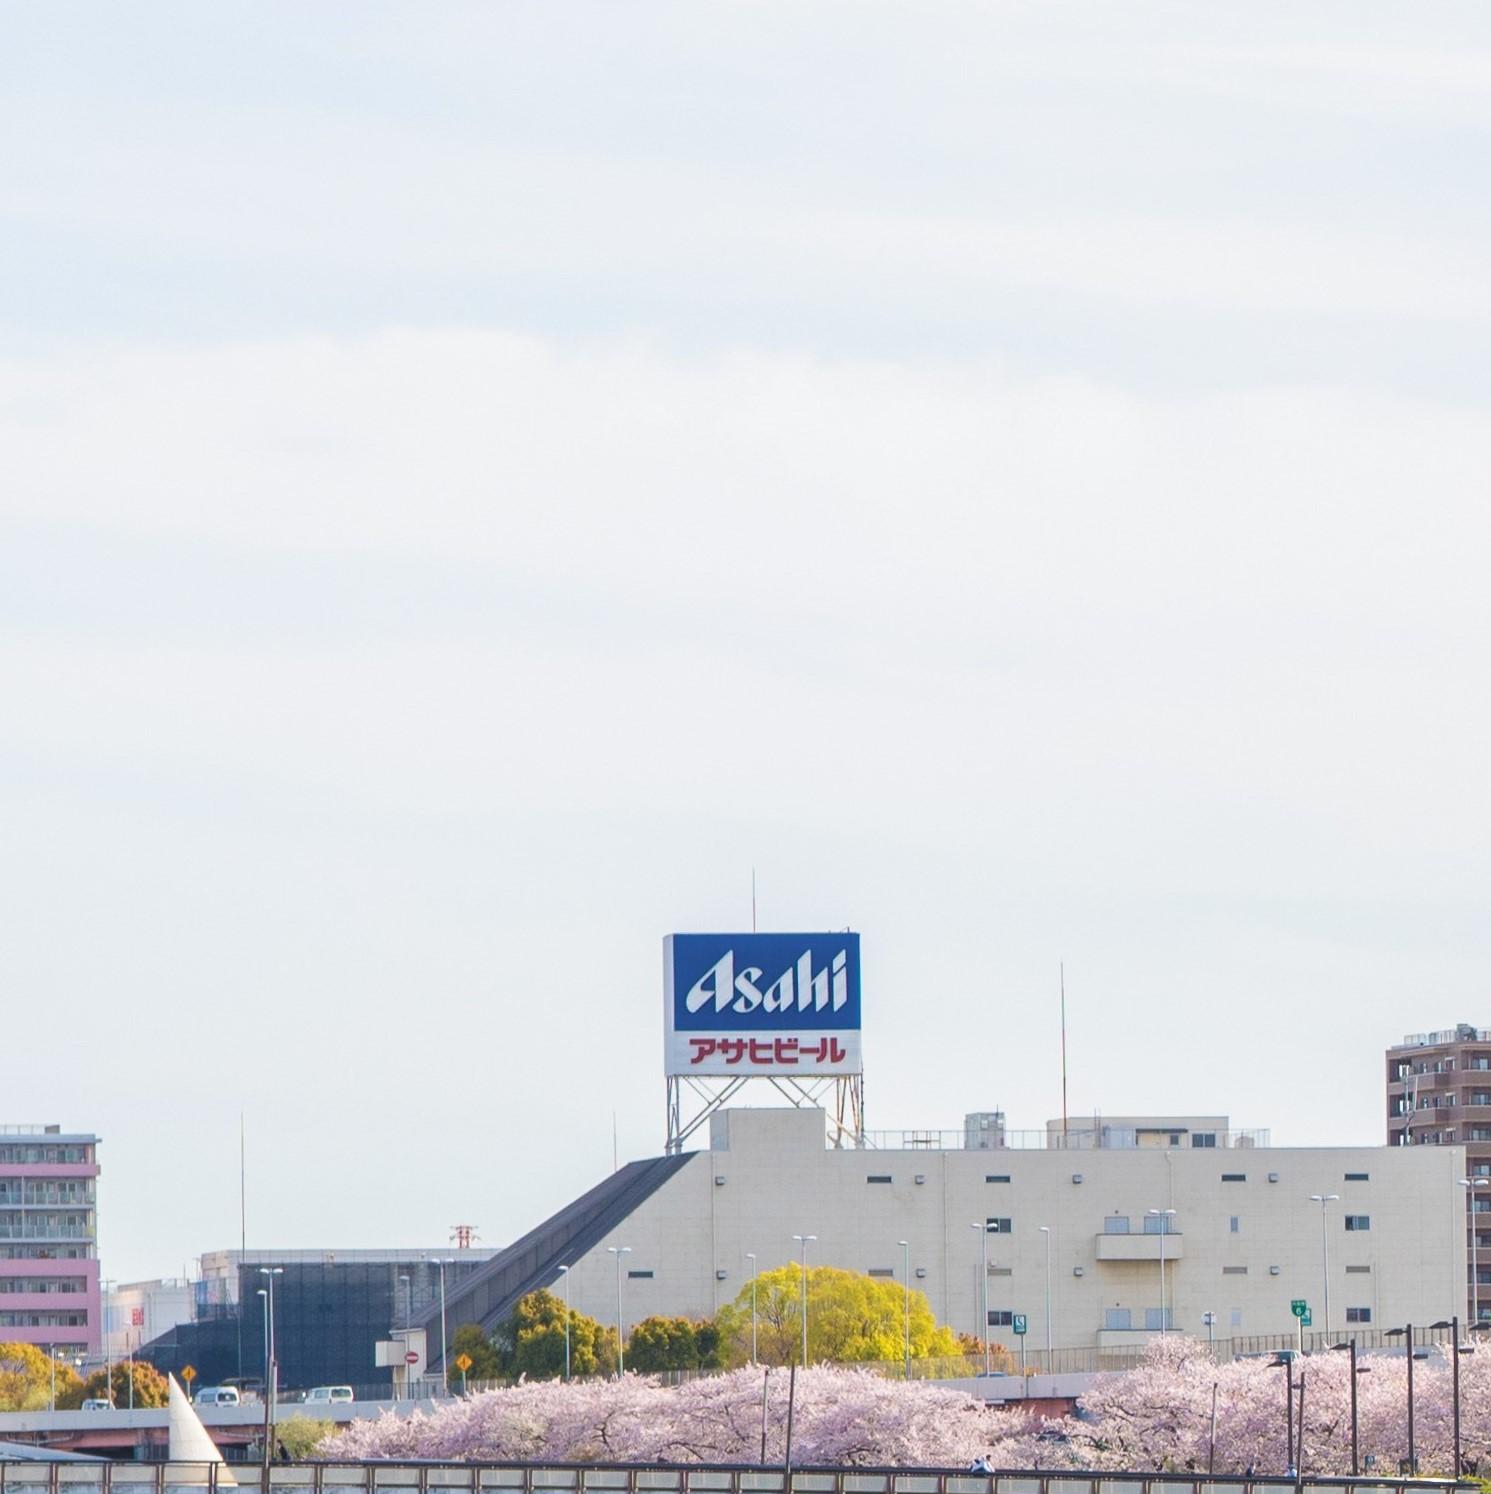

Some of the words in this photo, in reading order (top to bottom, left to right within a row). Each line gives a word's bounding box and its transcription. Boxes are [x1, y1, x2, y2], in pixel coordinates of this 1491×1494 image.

[685, 948, 848, 1014] Asahi
[689, 1036, 846, 1065] アサヒビール
[1296, 1307, 1302, 1315] 6
